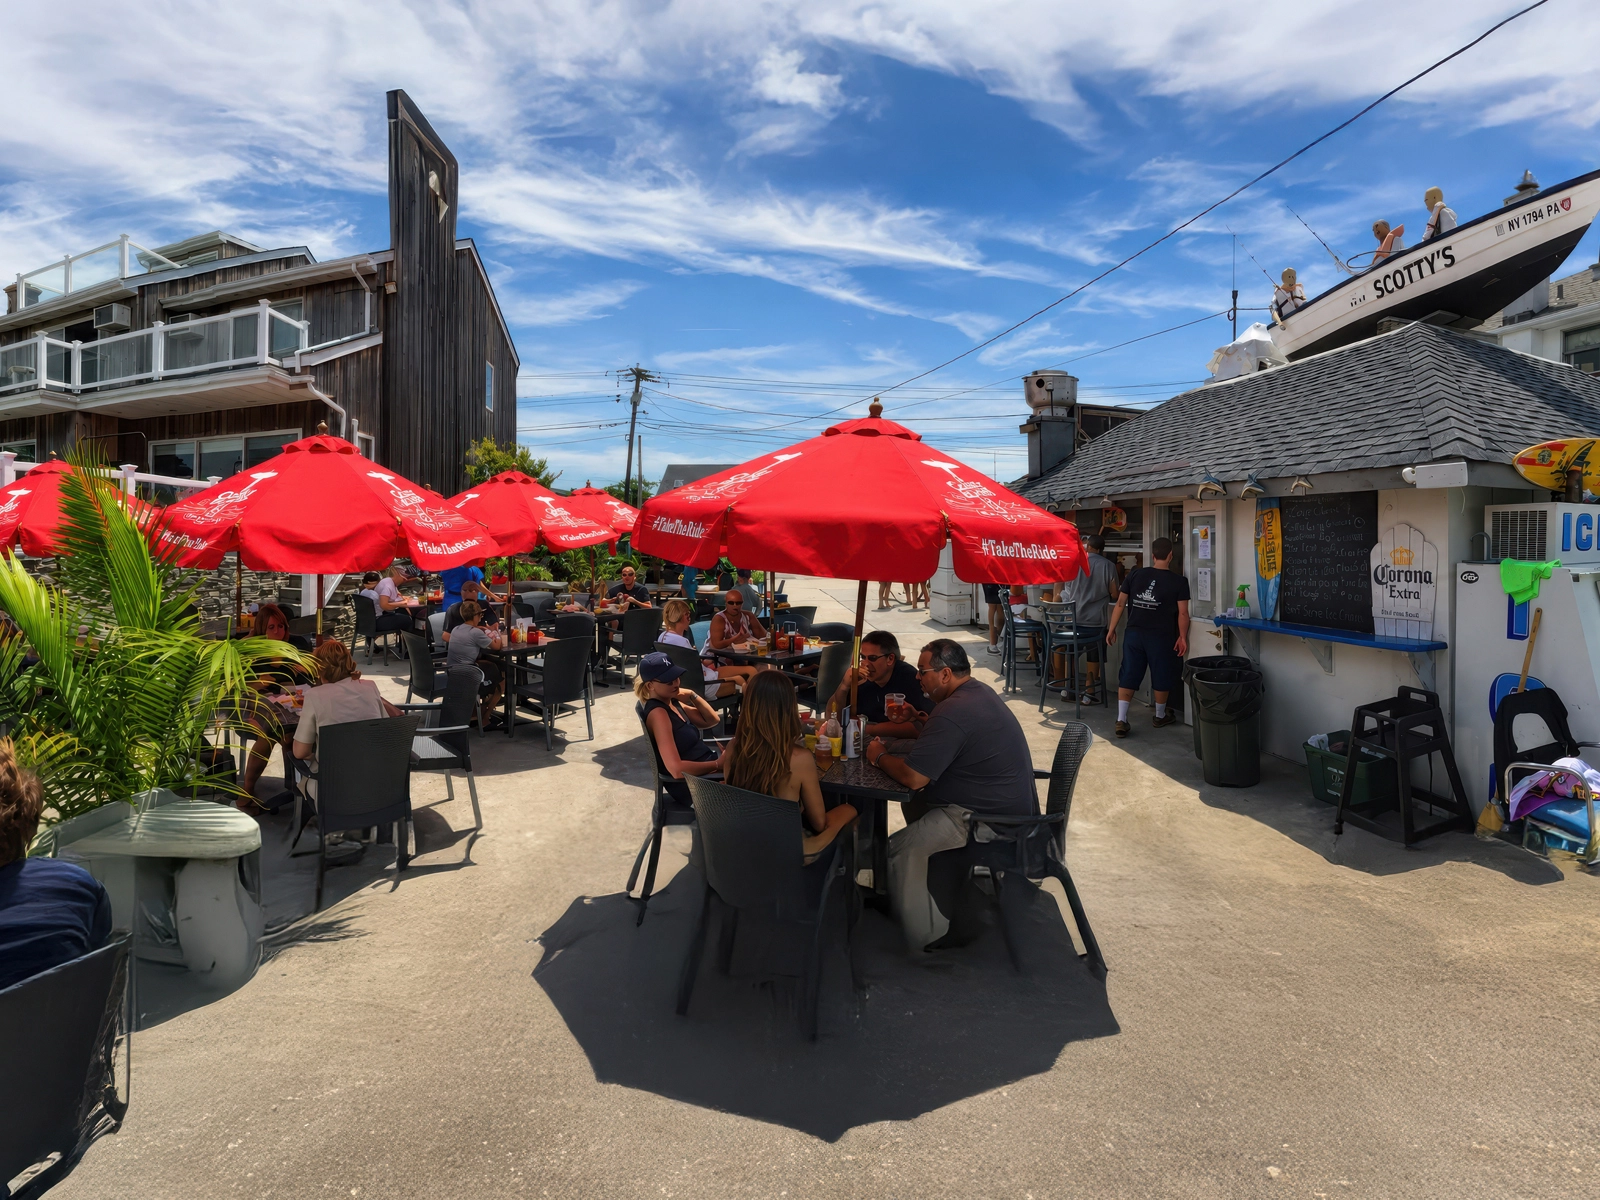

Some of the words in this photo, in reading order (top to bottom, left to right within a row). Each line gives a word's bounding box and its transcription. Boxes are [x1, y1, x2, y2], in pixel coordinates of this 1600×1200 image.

[1508, 217, 1520, 232] NY
[1522, 207, 1544, 225] 1794
[1547, 202, 1561, 218] PA
[1373, 245, 1456, 299] SCOTTY'S
[1562, 512, 1600, 552] IC
[981, 538, 1058, 560] #TakeTheRide
[1373, 564, 1434, 589] Corona
[1389, 585, 1421, 600] Extra
